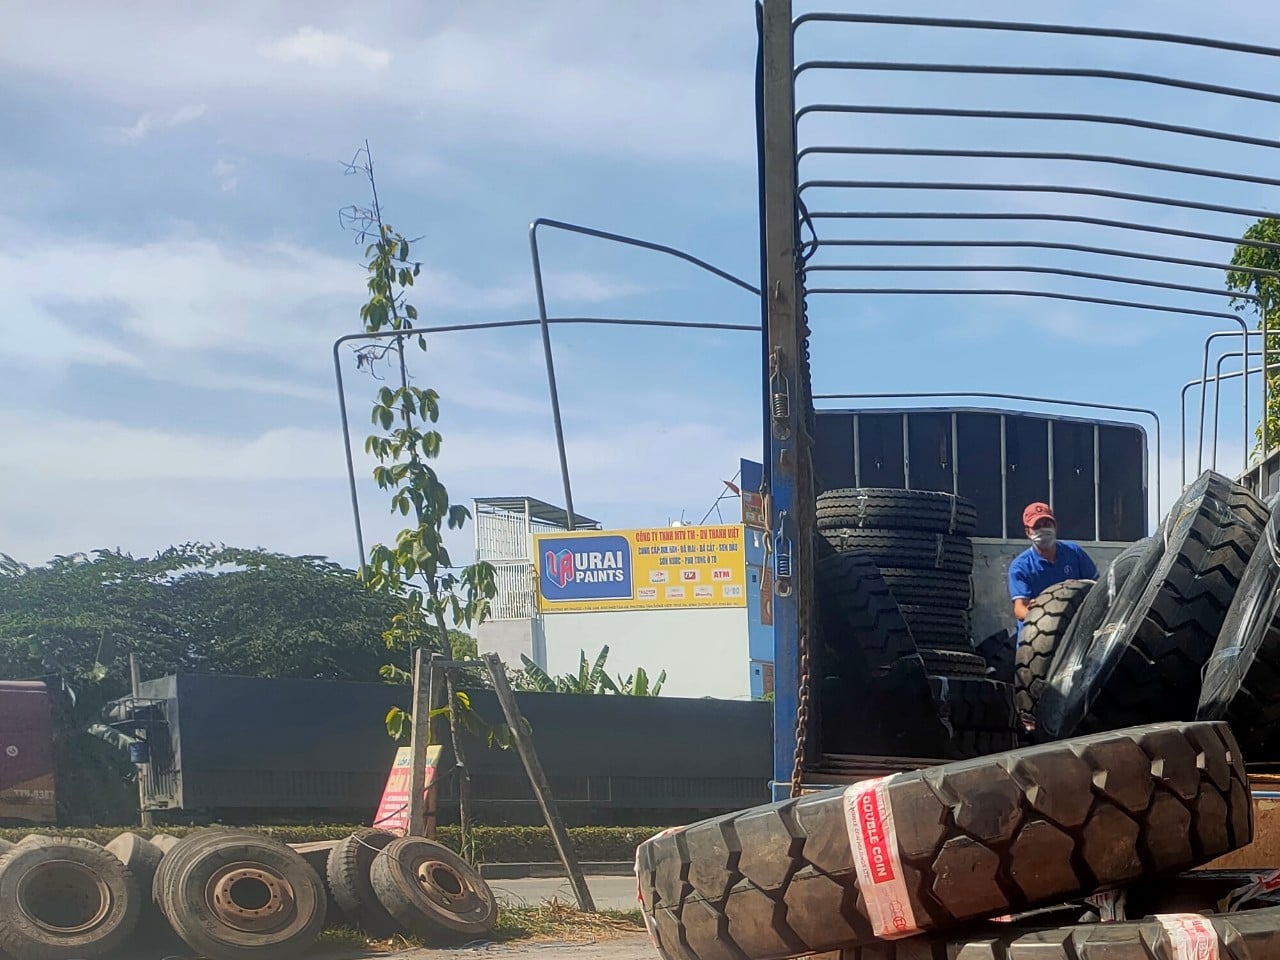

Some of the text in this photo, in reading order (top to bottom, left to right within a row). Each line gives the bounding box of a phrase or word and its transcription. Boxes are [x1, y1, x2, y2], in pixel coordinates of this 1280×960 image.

[575, 569, 624, 583] PAINTS
[713, 570, 730, 579] ATM
[871, 846, 888, 878] COIN
